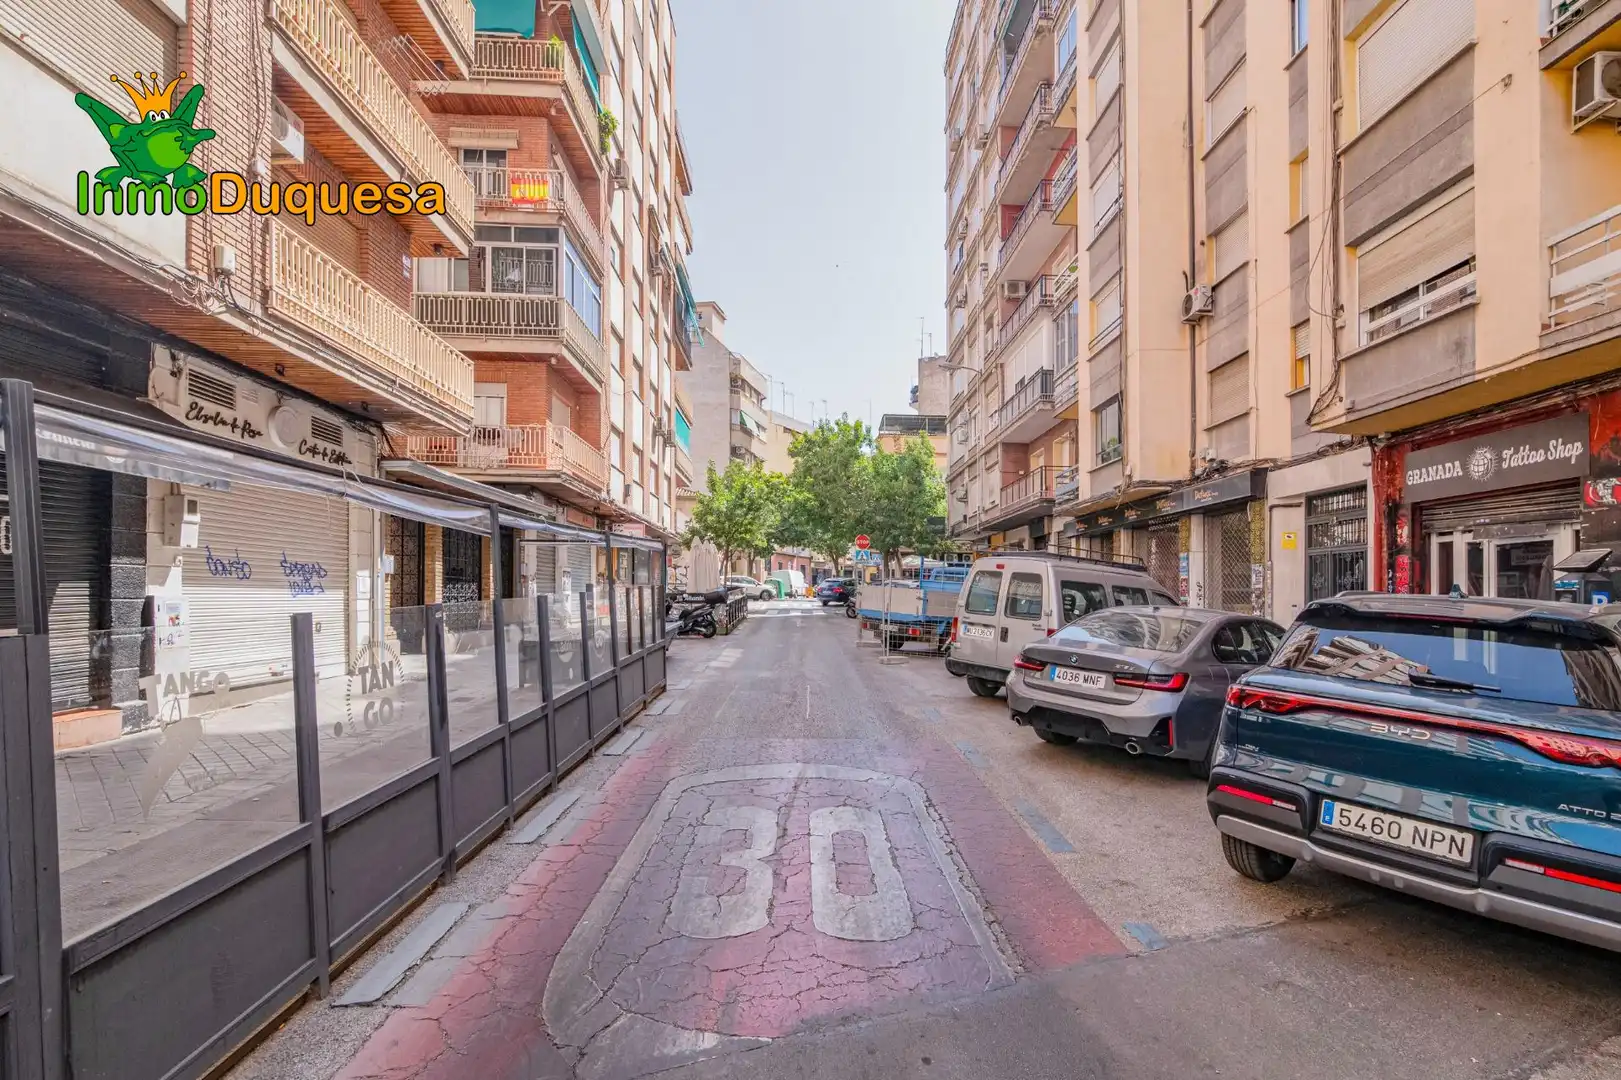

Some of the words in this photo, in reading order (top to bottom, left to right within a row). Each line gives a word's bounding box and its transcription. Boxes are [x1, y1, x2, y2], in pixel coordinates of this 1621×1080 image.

[1406, 460, 1463, 486] GRANADA
[1502, 446, 1545, 470] Tattoo
[1547, 438, 1583, 464] Shop
[139, 671, 230, 717] TANGO
[358, 661, 394, 694] TAN
[1056, 669, 1080, 682] 4036
[1083, 674, 1103, 686] MNF
[363, 696, 394, 730] GO
[1370, 723, 1430, 740] BYD
[1557, 803, 1606, 818] ATTO
[1338, 809, 1401, 840] 5460
[1412, 825, 1465, 858] NPN
[665, 805, 916, 942] 30
